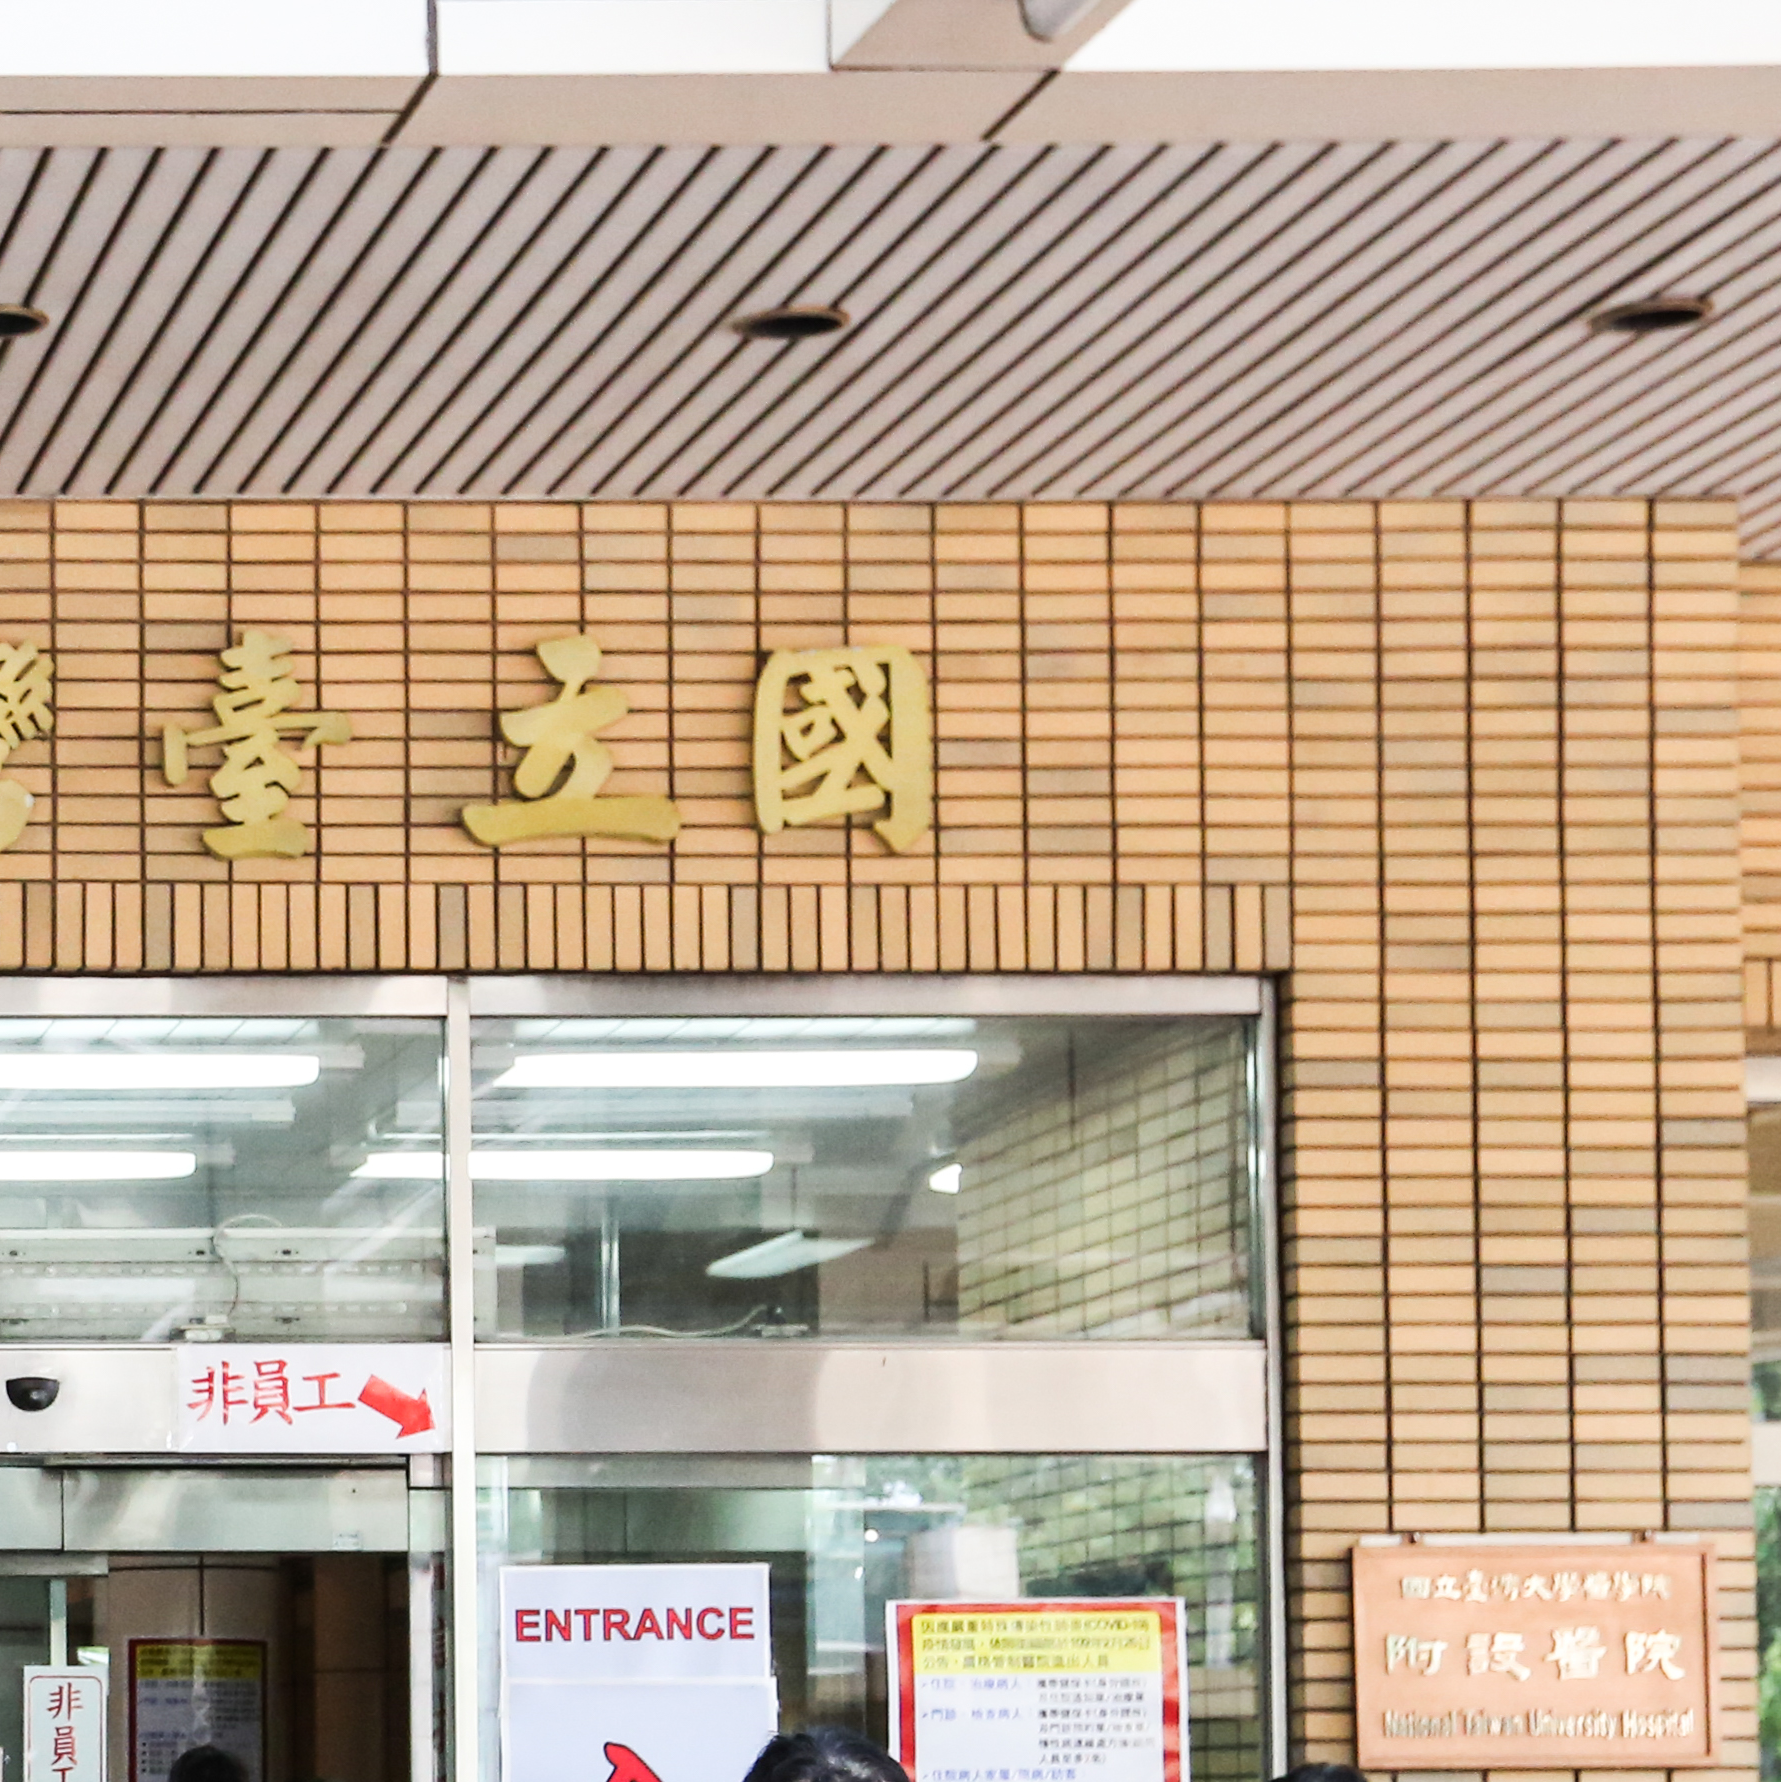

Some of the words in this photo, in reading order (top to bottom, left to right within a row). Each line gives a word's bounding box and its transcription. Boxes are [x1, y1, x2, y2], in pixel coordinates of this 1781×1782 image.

[188, 1360, 357, 1424] 非員工
[515, 1607, 755, 1642] ENTRANCE
[1385, 1625, 1686, 1681] 附設醫院
[1383, 1709, 1457, 1739] National
[1463, 1709, 1524, 1738] Taiwan
[1528, 1708, 1618, 1740] University
[1621, 1707, 1695, 1740] Hospital
